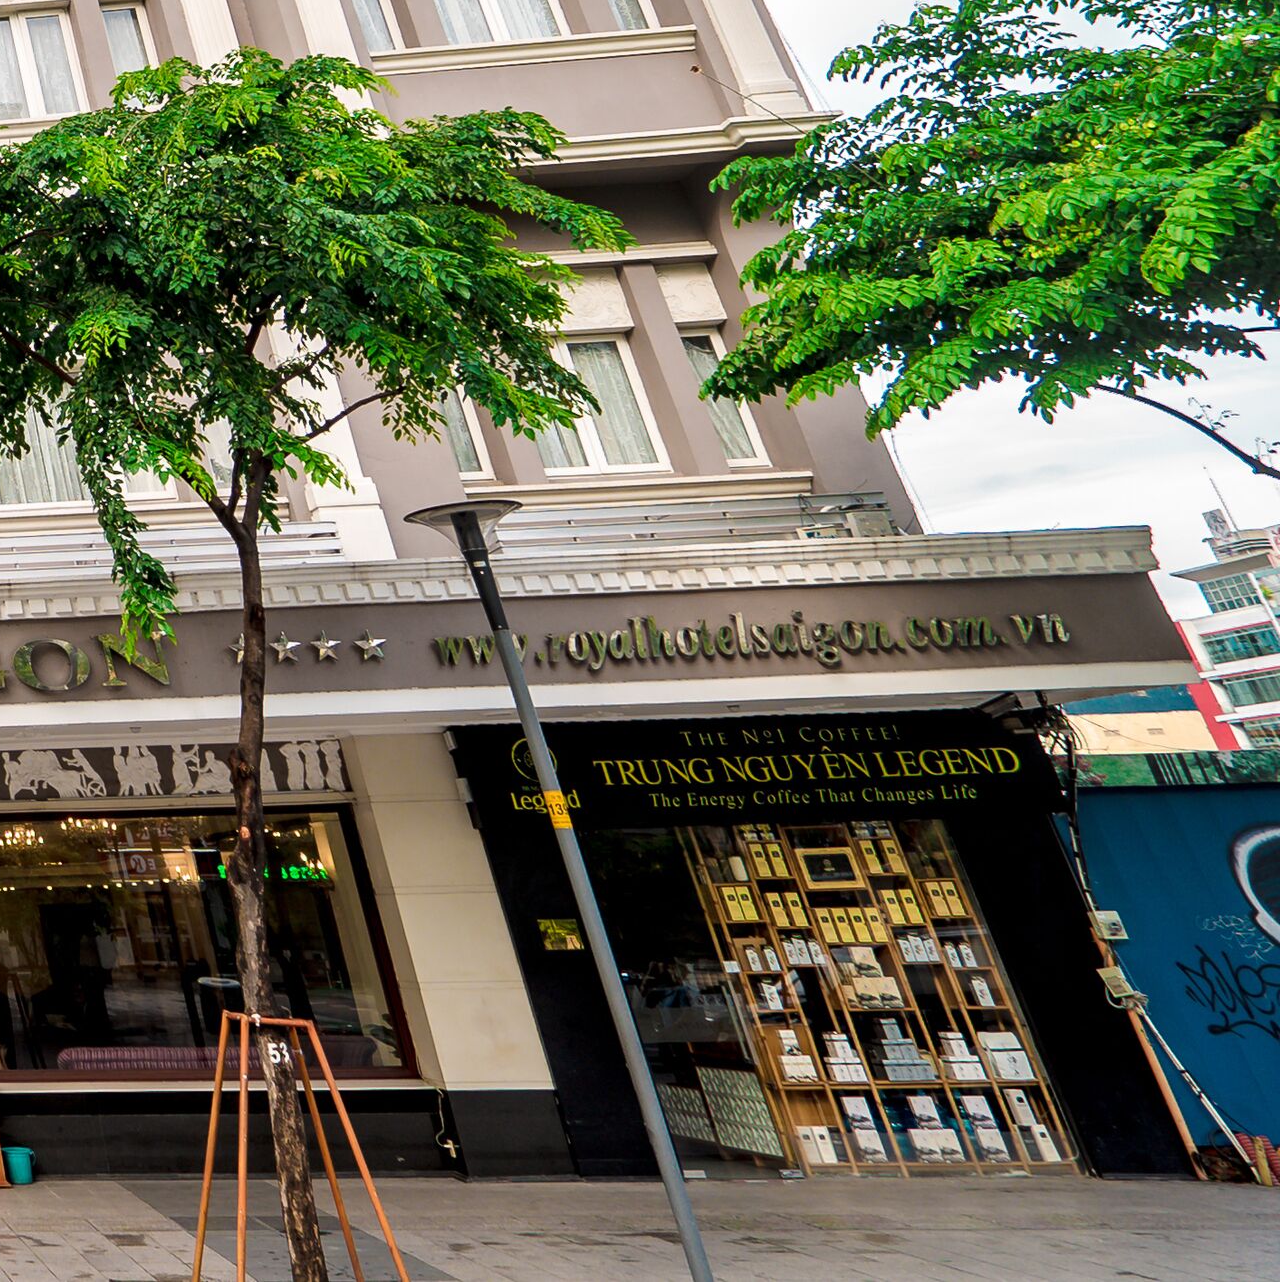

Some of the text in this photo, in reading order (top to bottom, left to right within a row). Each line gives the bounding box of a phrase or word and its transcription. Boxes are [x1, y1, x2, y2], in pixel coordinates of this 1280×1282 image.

[593, 745, 1020, 786] TRUNG NGUYÊN LEGEND
[510, 789, 581, 814] Legd
[648, 784, 978, 811] The Energy Coffee That Changes Life
